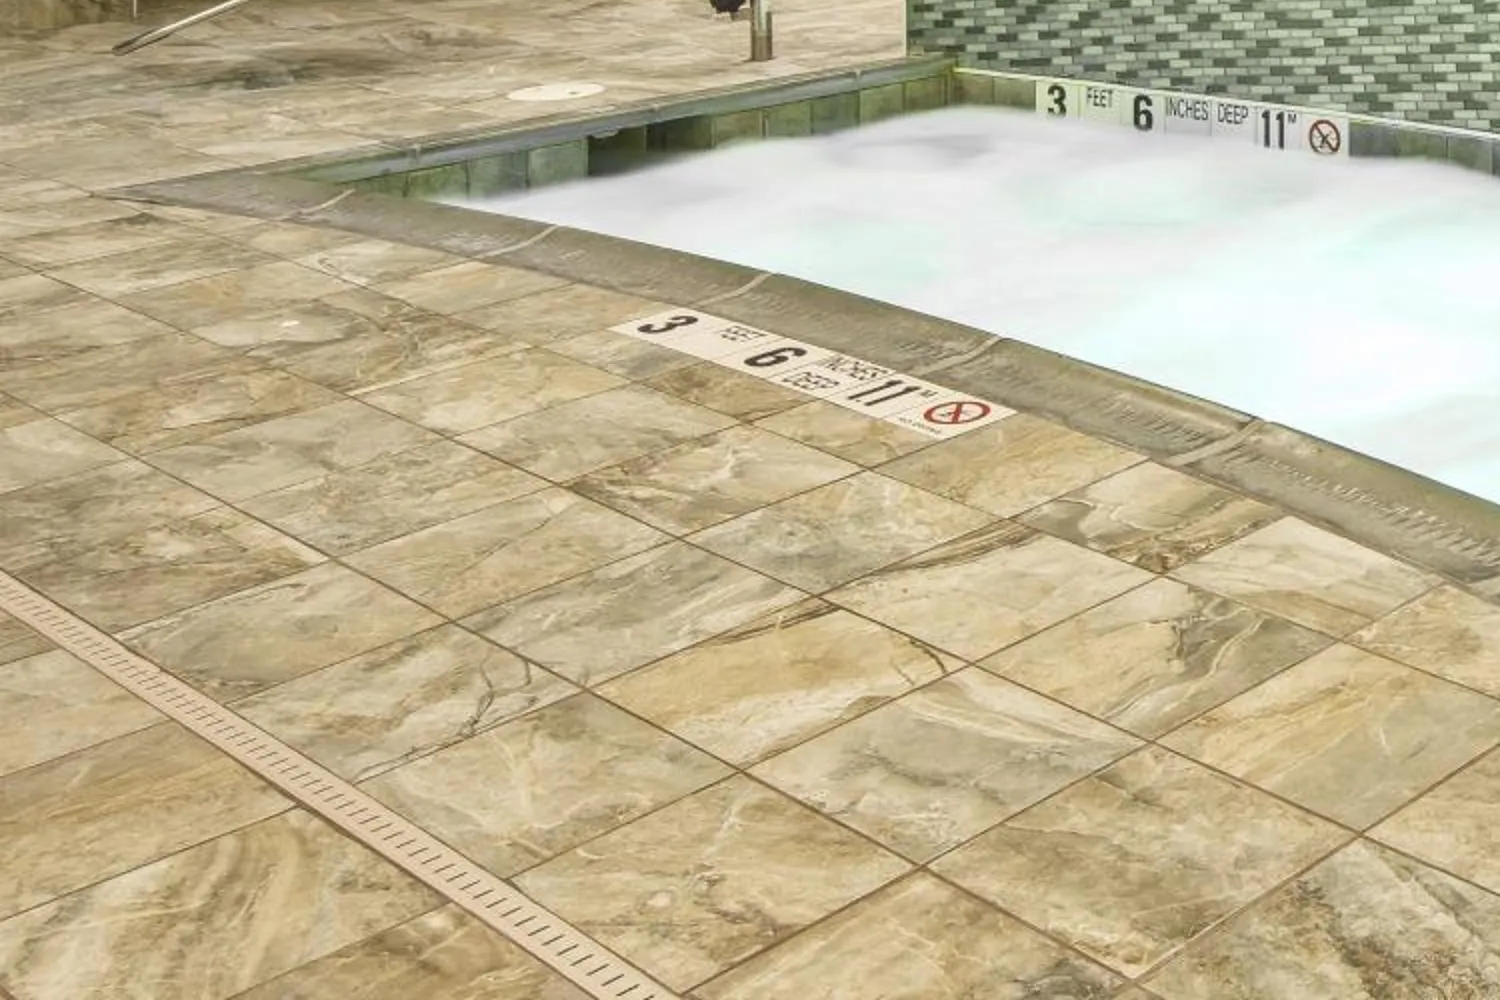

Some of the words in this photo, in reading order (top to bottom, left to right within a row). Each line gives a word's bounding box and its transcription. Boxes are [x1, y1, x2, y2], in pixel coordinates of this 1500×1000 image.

[1047, 84, 1067, 117] 3
[1086, 87, 1112, 107] FEET
[1133, 94, 1153, 131] 6
[1165, 97, 1208, 121] INCHES
[1217, 103, 1248, 125] DEEP
[637, 315, 698, 334] 3
[744, 347, 807, 367] 6
